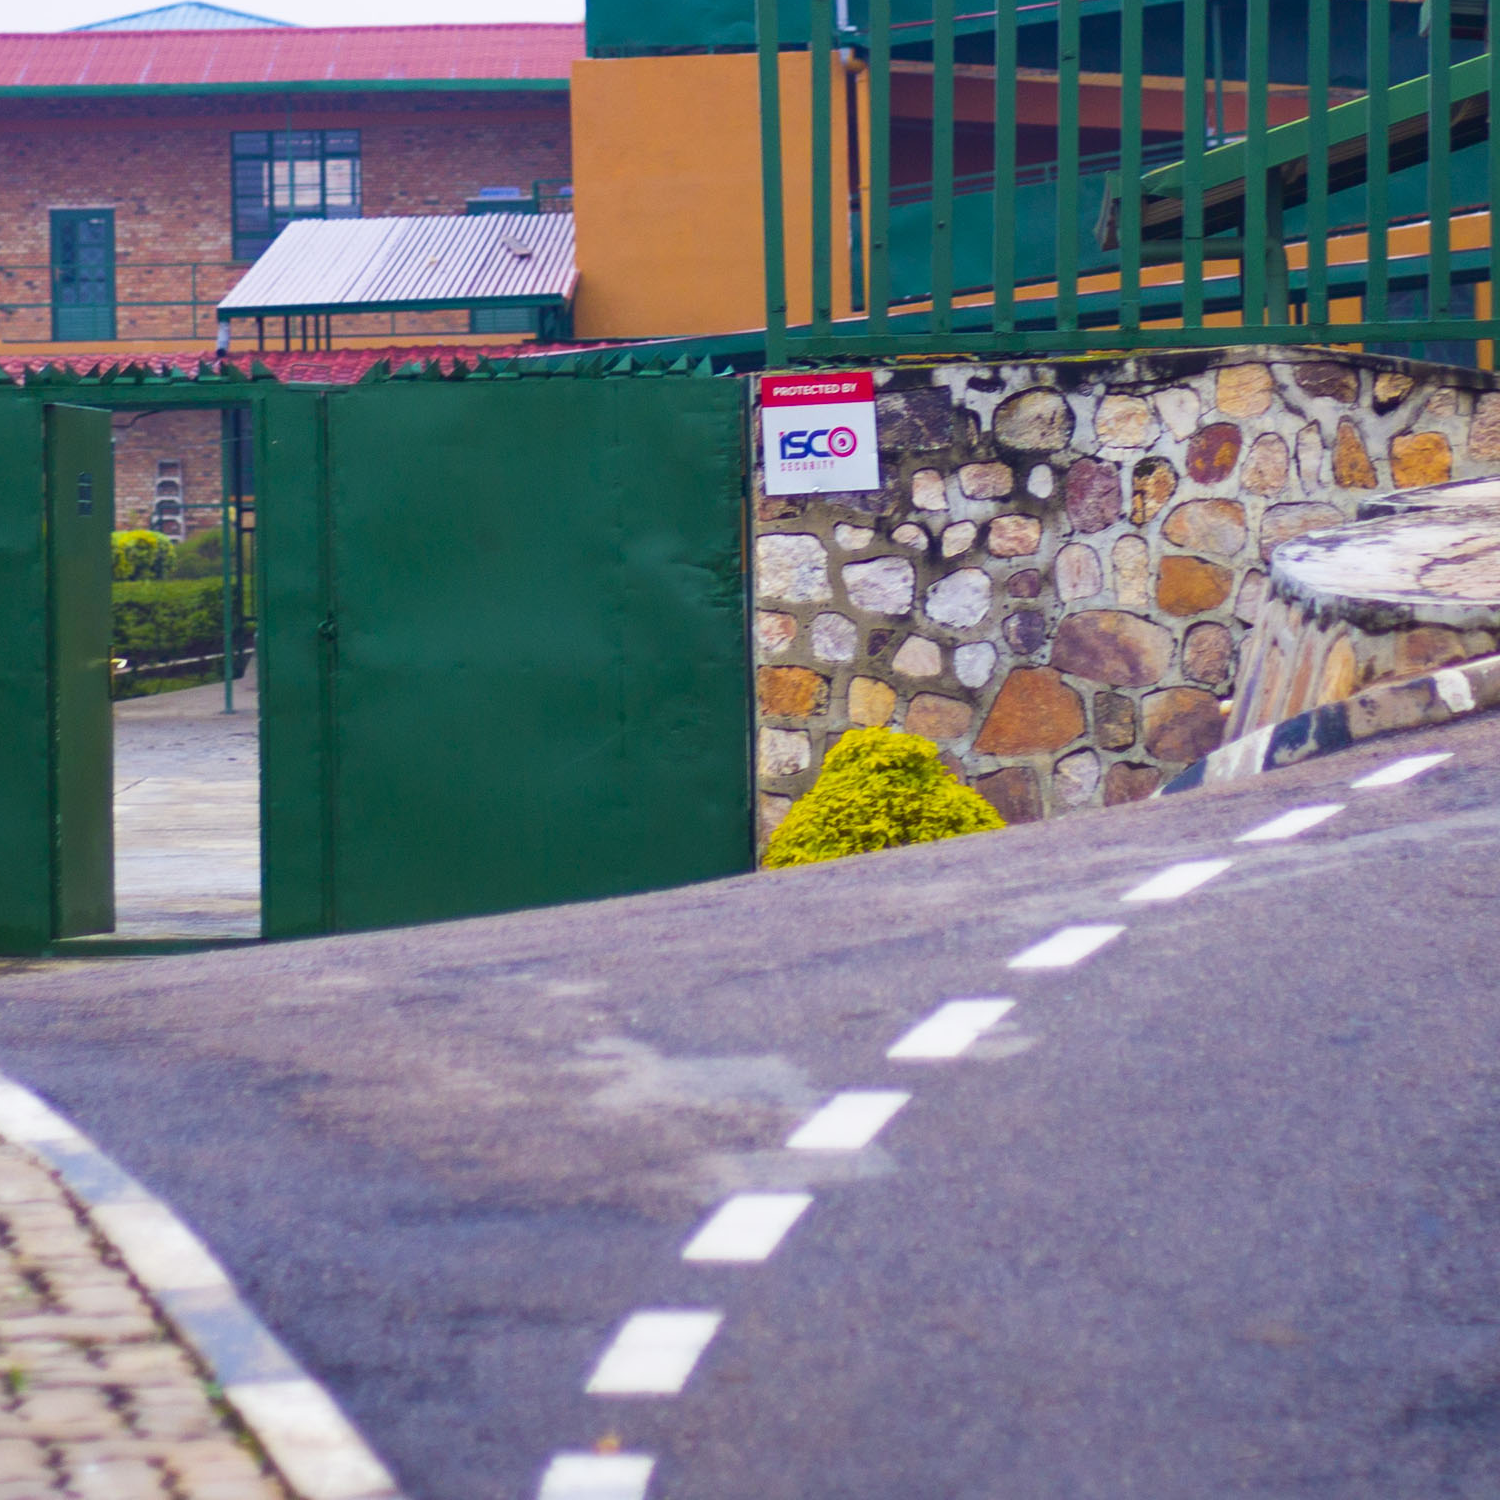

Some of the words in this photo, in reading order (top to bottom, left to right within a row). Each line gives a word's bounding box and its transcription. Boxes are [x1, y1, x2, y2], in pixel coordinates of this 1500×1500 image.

[772, 384, 840, 397] PROTECTED
[841, 383, 857, 393] BY
[780, 460, 835, 472] SECURITY
